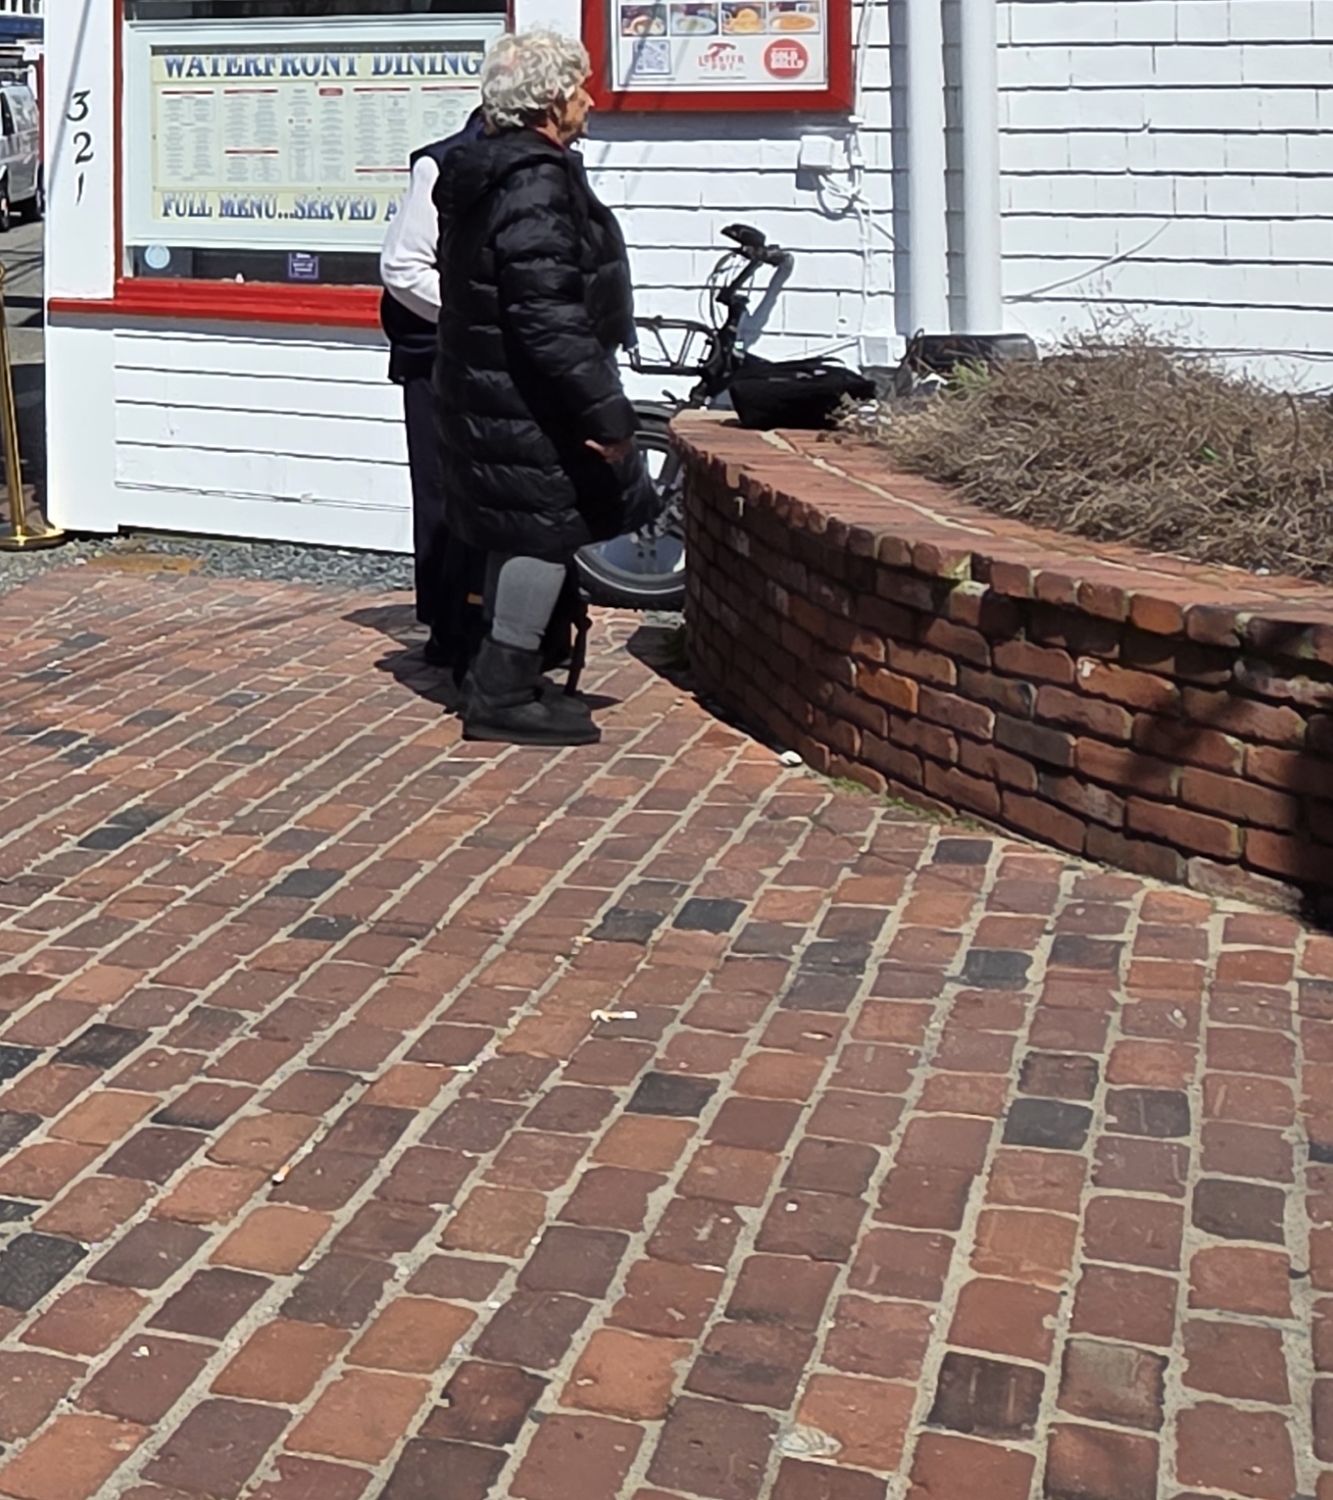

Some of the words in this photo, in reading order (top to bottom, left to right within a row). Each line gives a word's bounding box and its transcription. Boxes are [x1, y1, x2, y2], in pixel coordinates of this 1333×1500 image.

[164, 50, 361, 78] WATERFRONT
[372, 49, 483, 77] DINING
[162, 193, 213, 218] FULL
